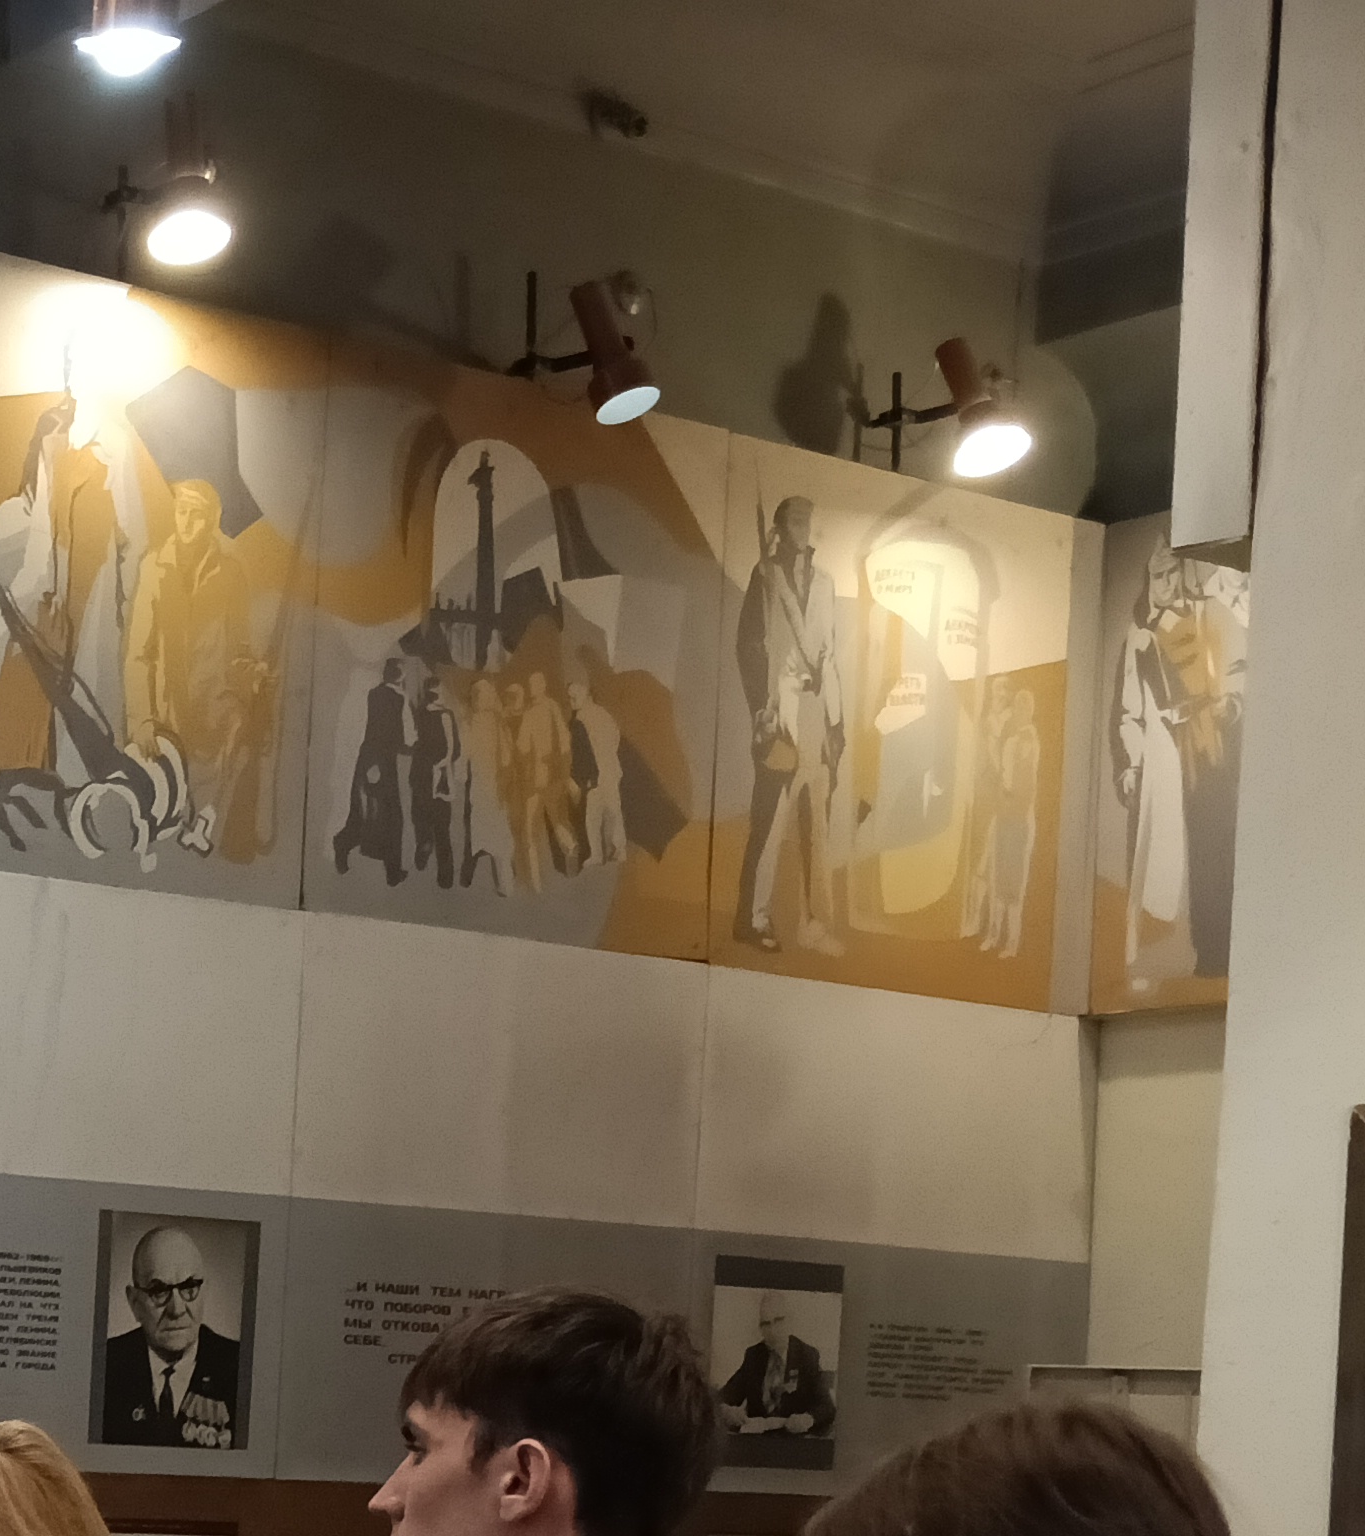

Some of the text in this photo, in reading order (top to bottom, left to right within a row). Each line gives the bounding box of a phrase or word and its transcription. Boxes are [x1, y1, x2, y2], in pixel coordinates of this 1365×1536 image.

[374, 1282, 507, 1301] НАШИ ТЕМ НАГР
[344, 1298, 451, 1315] ЧТО ПОБОРОВ
[343, 1317, 441, 1334] МЫ ОТКОВА
